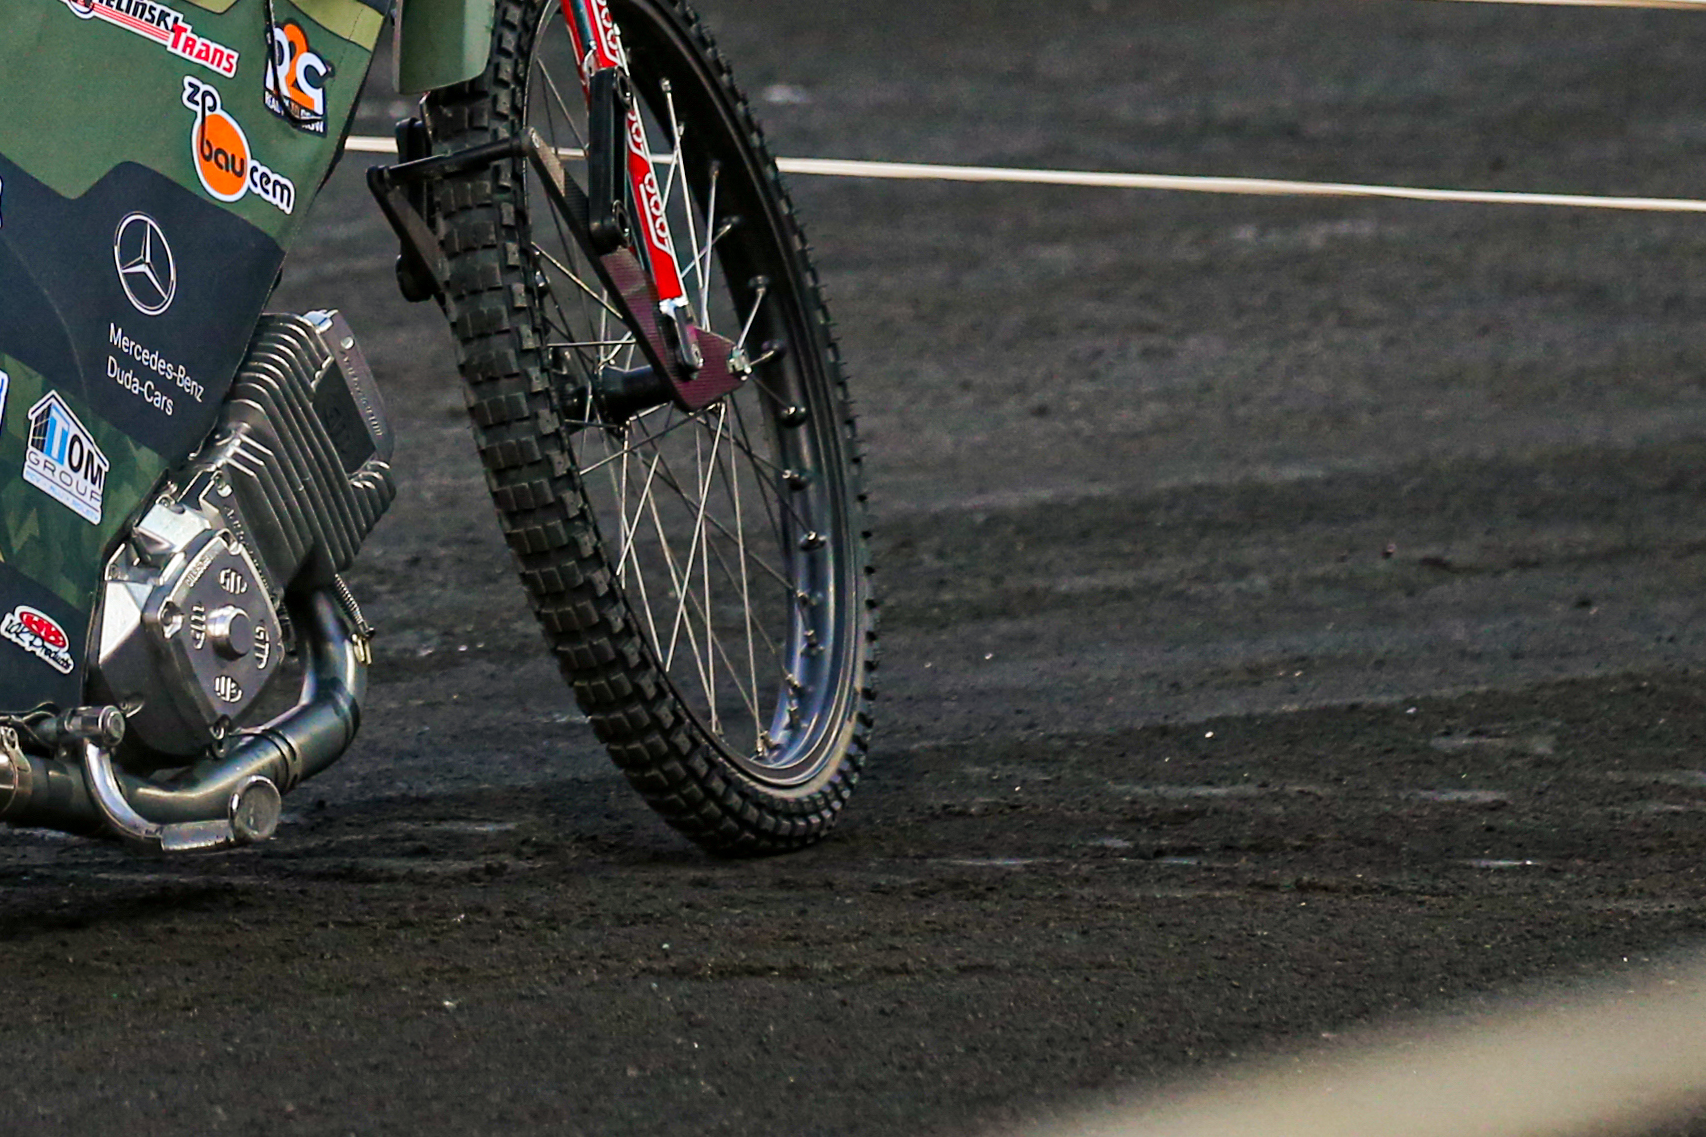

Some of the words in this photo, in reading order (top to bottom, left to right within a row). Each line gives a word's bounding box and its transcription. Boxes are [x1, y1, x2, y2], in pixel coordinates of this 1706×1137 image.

[107, 355, 174, 416] Duda-Cars
[109, 322, 205, 403] Mercedes-Benz
[43, 407, 105, 490] TOM
